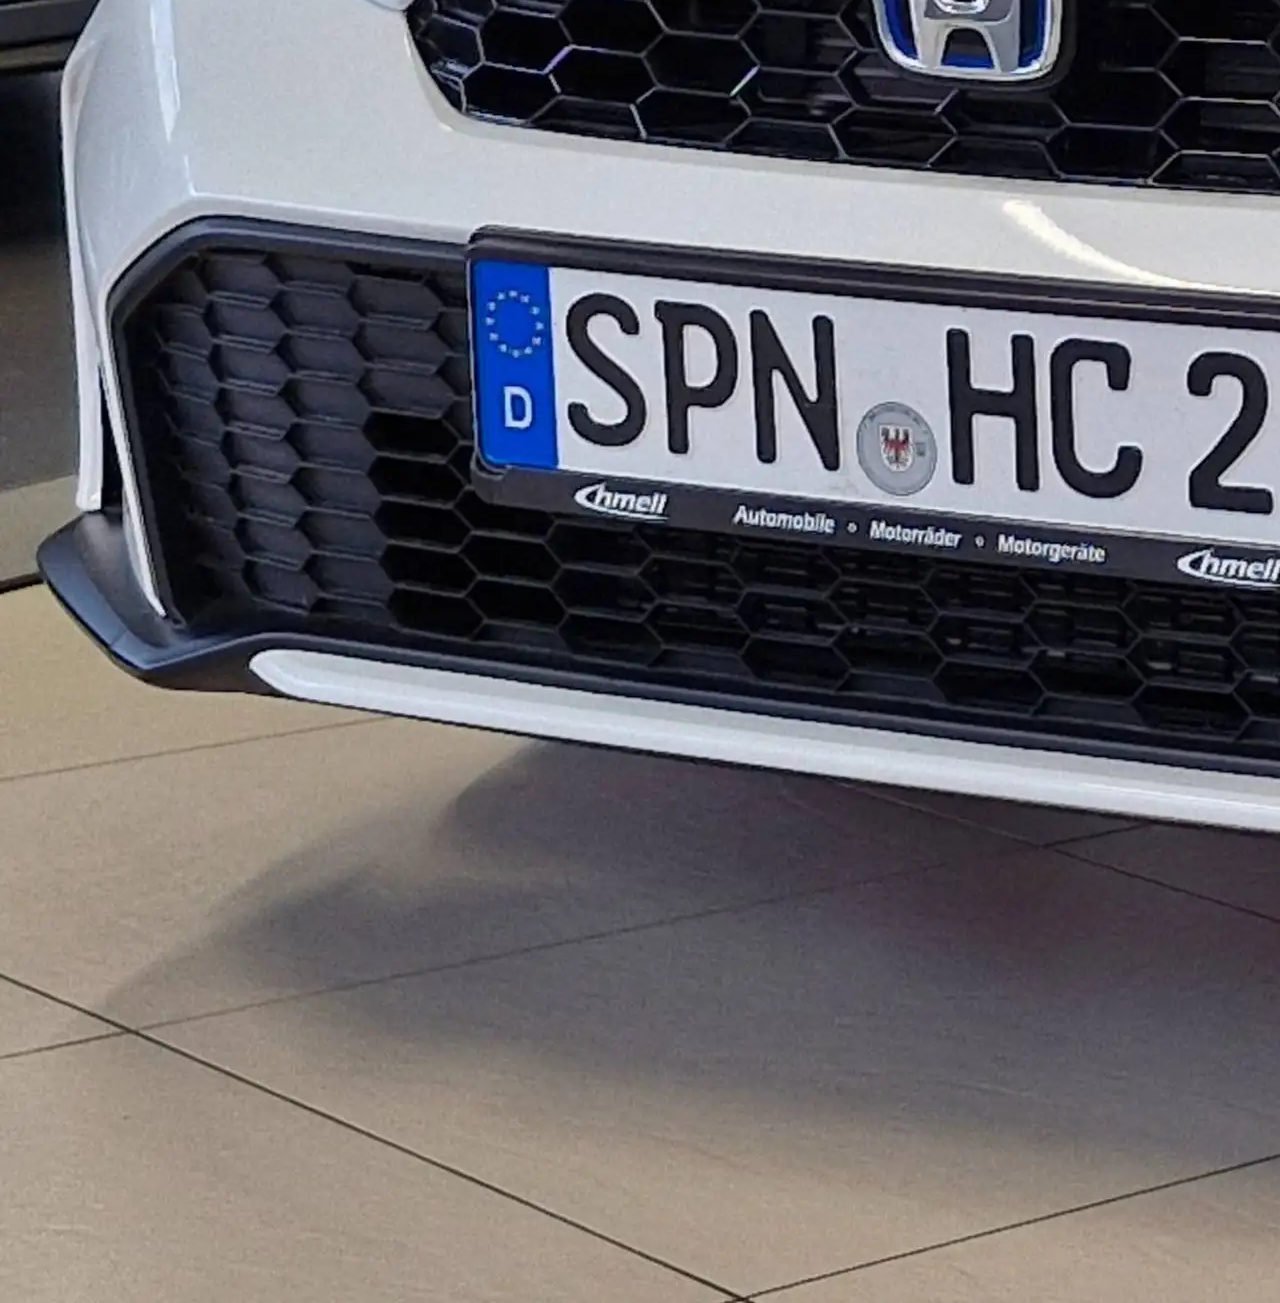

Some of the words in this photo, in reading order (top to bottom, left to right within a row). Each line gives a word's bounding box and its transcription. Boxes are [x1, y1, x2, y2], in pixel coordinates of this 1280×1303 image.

[504, 386, 532, 429] D
[566, 294, 839, 471] SPN
[947, 329, 1142, 498] HC
[732, 505, 836, 534] Automobile
[870, 520, 962, 548] Motorräder
[998, 533, 1106, 563] Motorgeräte
